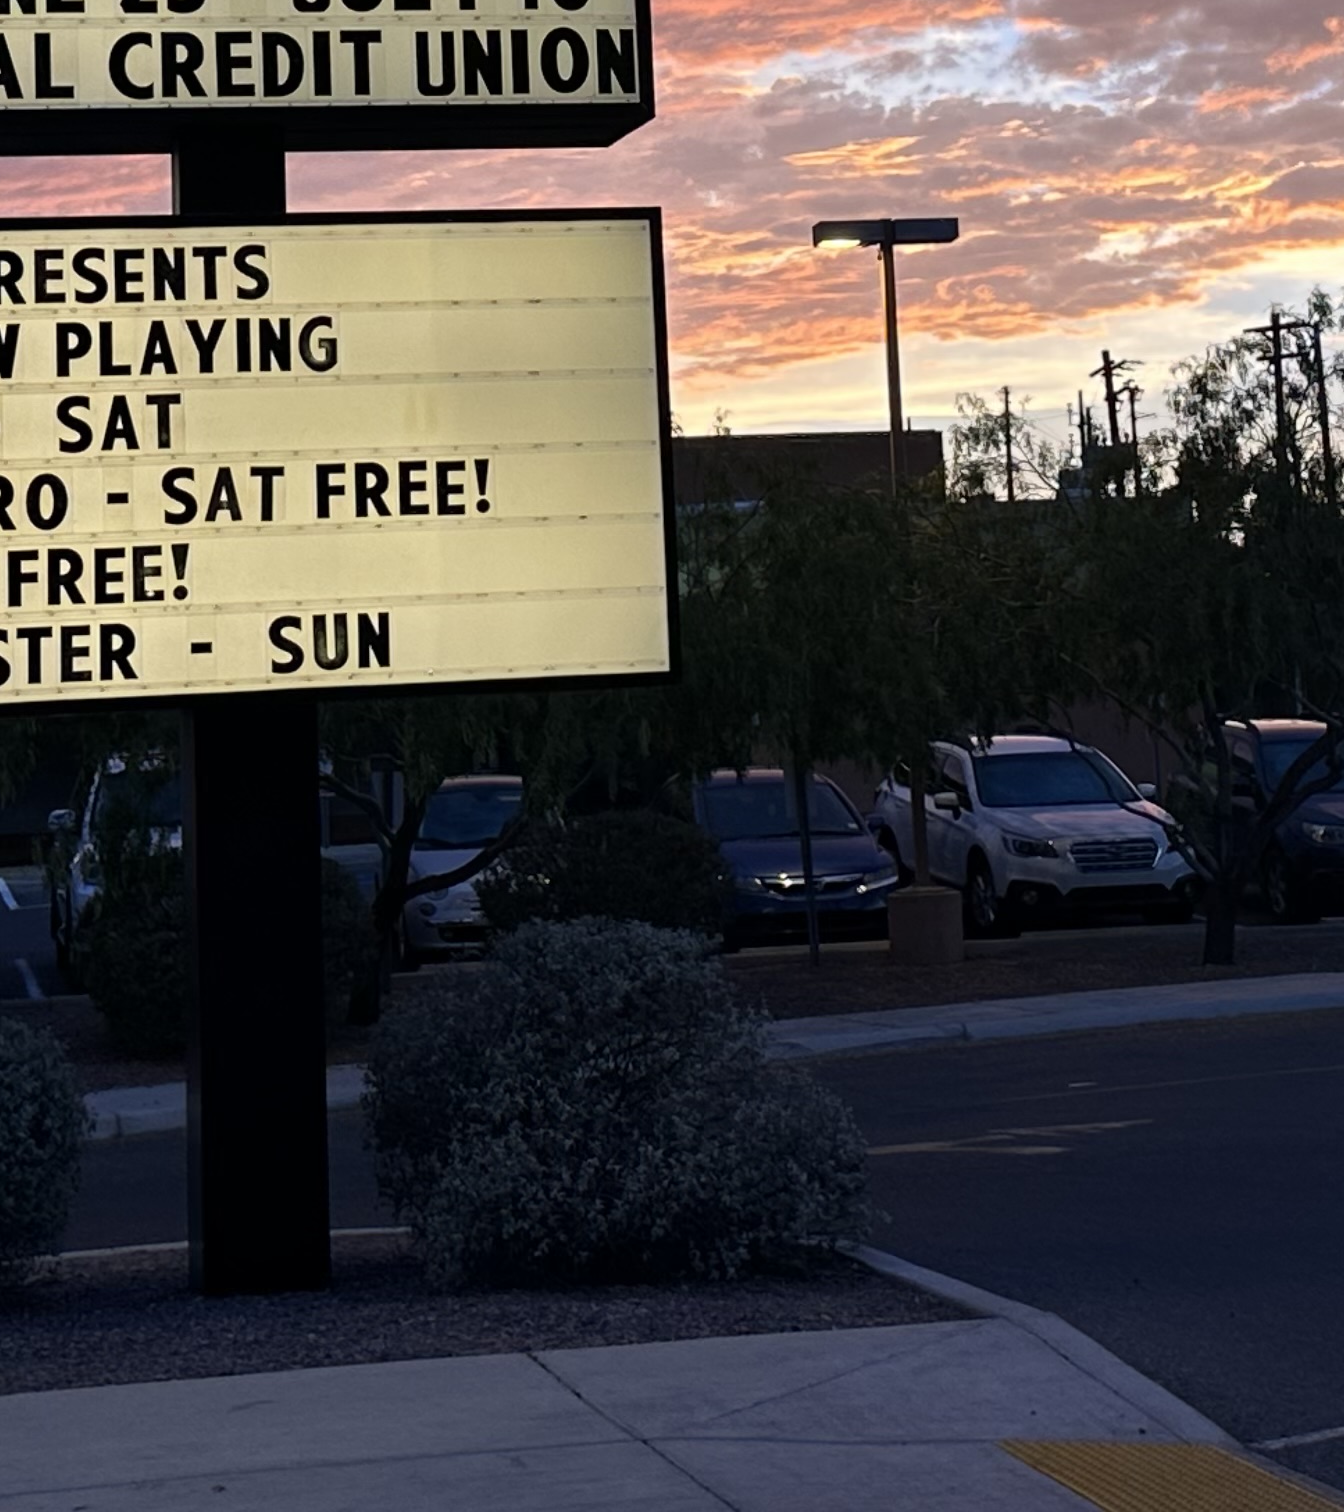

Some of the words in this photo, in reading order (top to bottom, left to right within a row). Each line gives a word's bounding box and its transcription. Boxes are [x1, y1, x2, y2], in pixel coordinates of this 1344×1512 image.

[109, 30, 381, 99] CREDIT
[416, 27, 636, 96] UNION
[56, 316, 337, 377] PLAYING
[57, 394, 180, 453] SAT
[162, 467, 284, 524] SAT
[316, 459, 490, 518] FREE!
[8, 544, 189, 607] FREE!
[269, 613, 390, 673] SUN
